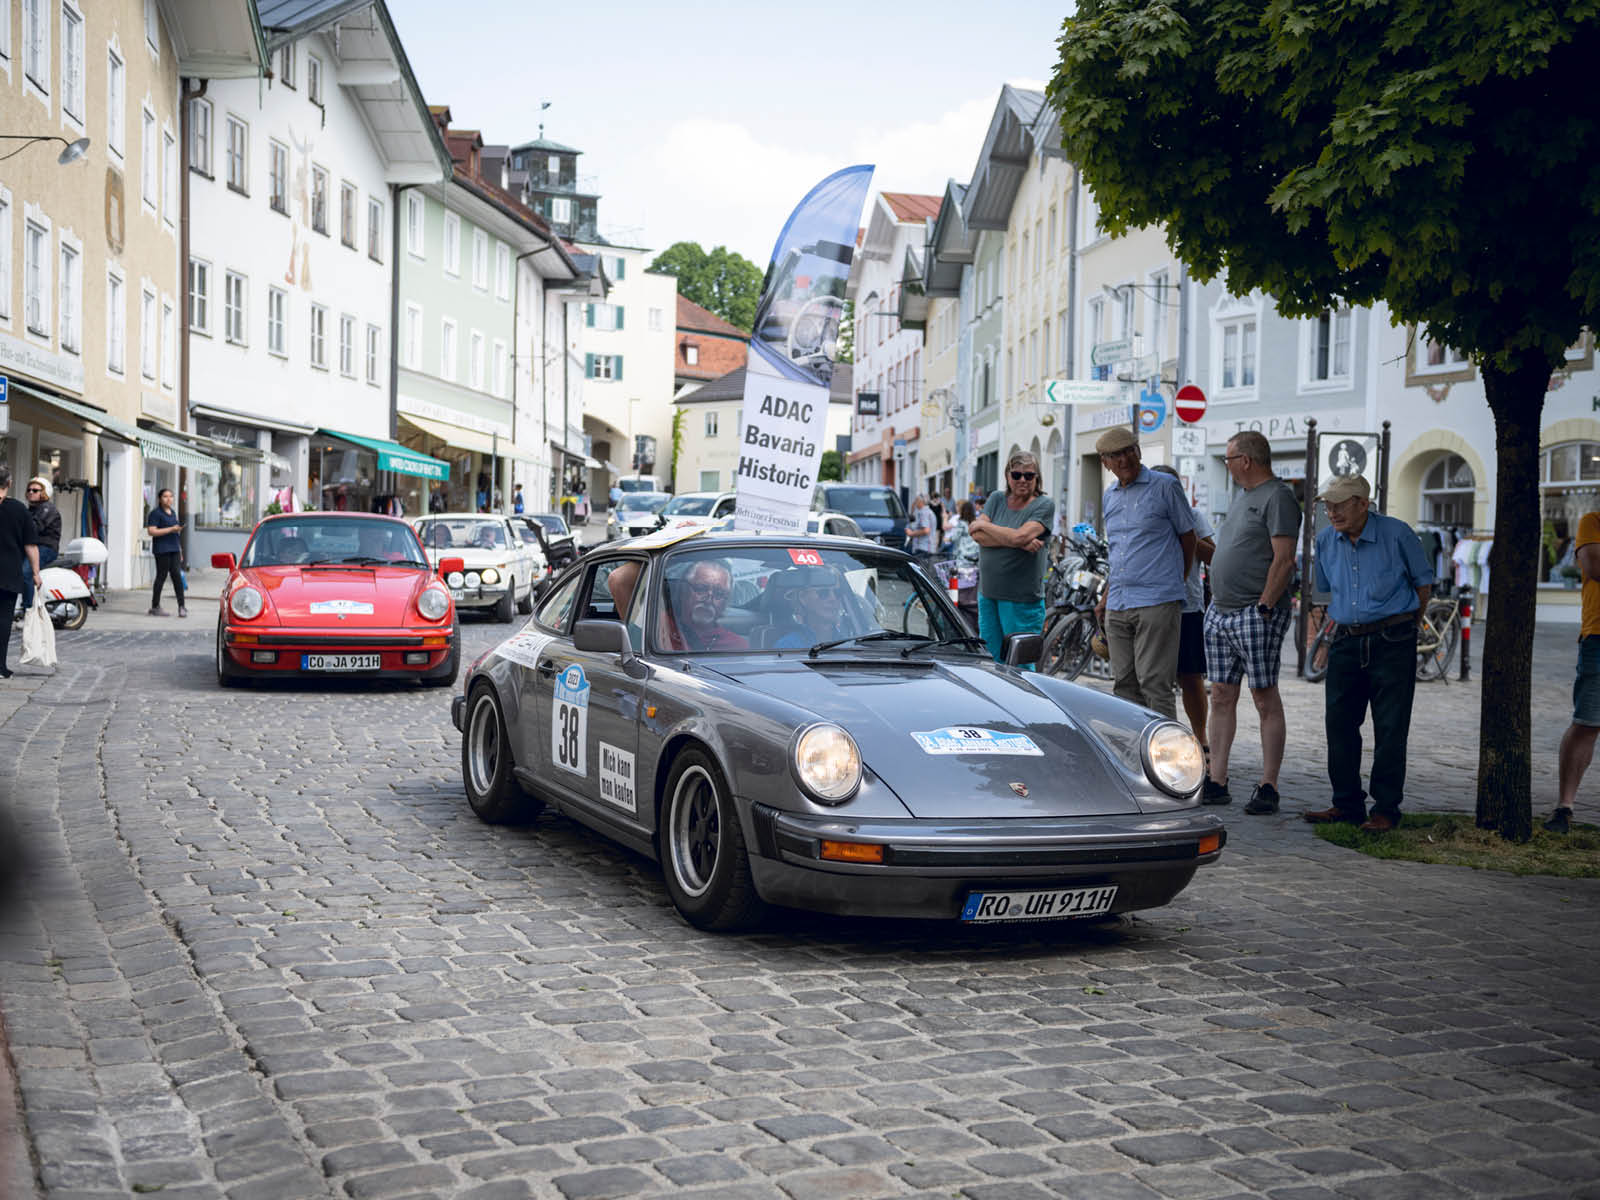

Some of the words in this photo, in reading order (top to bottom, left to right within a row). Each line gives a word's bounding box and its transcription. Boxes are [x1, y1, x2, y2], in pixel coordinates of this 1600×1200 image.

[759, 394, 814, 424] ADAC
[744, 423, 816, 457] Bavaria
[737, 455, 811, 490] Historic
[796, 553, 819, 565] 40
[309, 656, 324, 668] CO
[332, 656, 348, 668] JA
[350, 656, 380, 668] 911H
[558, 703, 580, 768] 38
[958, 729, 982, 739] 38
[602, 747, 616, 774] Mich
[617, 753, 632, 778] kann
[602, 777, 613, 797] man
[613, 777, 634, 808] kaufen
[978, 895, 1010, 917] RO
[1024, 893, 1058, 915] UH
[1058, 888, 1116, 914] 911H
